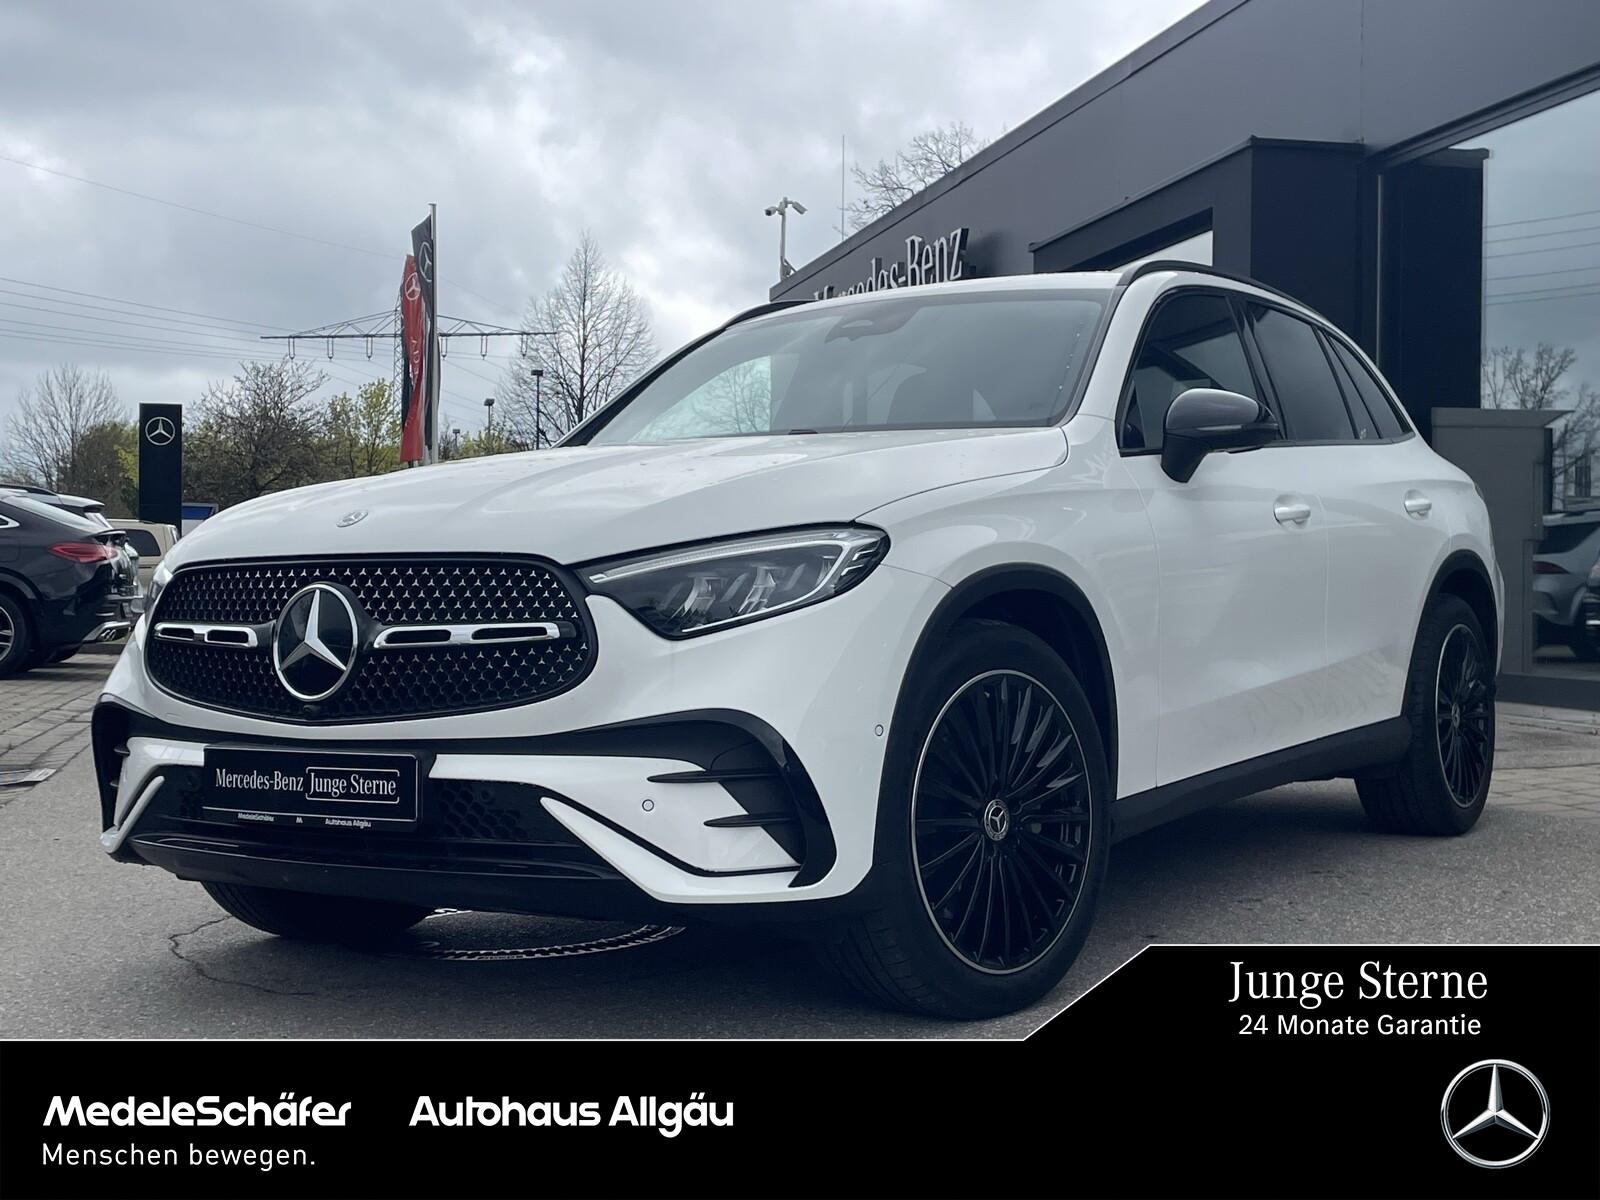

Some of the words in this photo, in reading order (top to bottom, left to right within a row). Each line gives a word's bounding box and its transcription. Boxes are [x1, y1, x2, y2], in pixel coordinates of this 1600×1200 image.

[813, 227, 968, 300] des-Benz
[215, 768, 304, 792] Mercedes-Benz
[309, 772, 348, 798] Junge
[350, 774, 396, 796] Sterne
